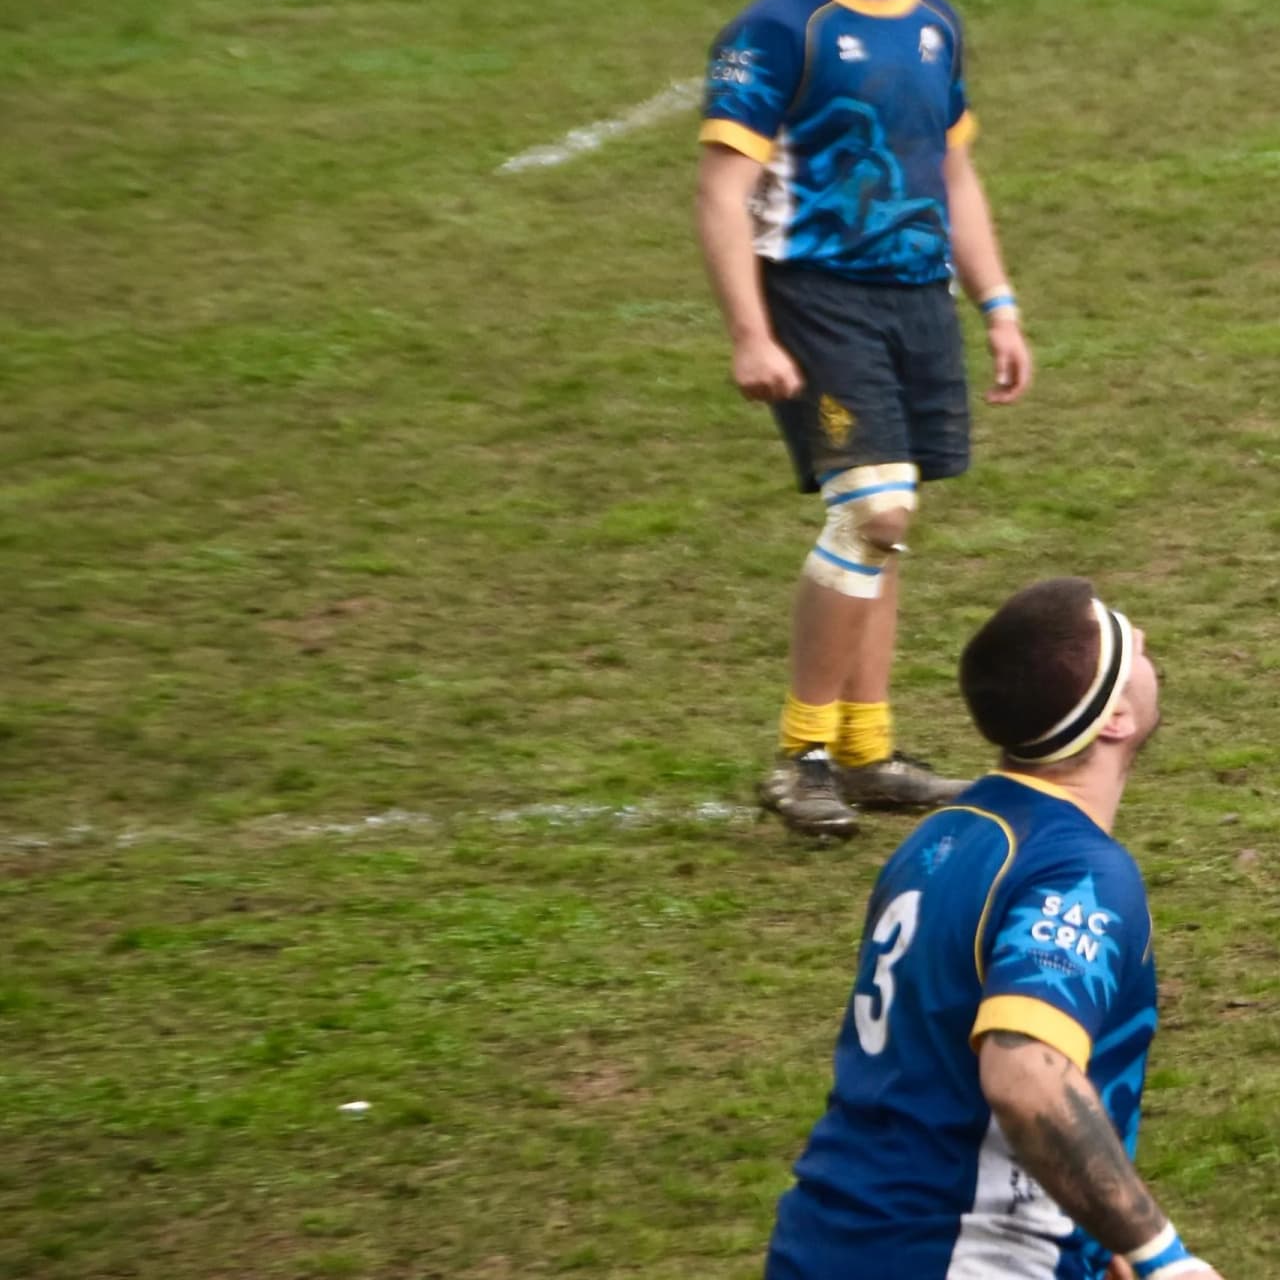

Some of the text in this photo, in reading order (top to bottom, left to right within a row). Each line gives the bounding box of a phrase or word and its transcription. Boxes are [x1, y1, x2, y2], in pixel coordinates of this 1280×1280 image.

[1042, 894, 1111, 937] SAC
[1031, 919, 1100, 964] CON
[853, 888, 924, 1057] 3
